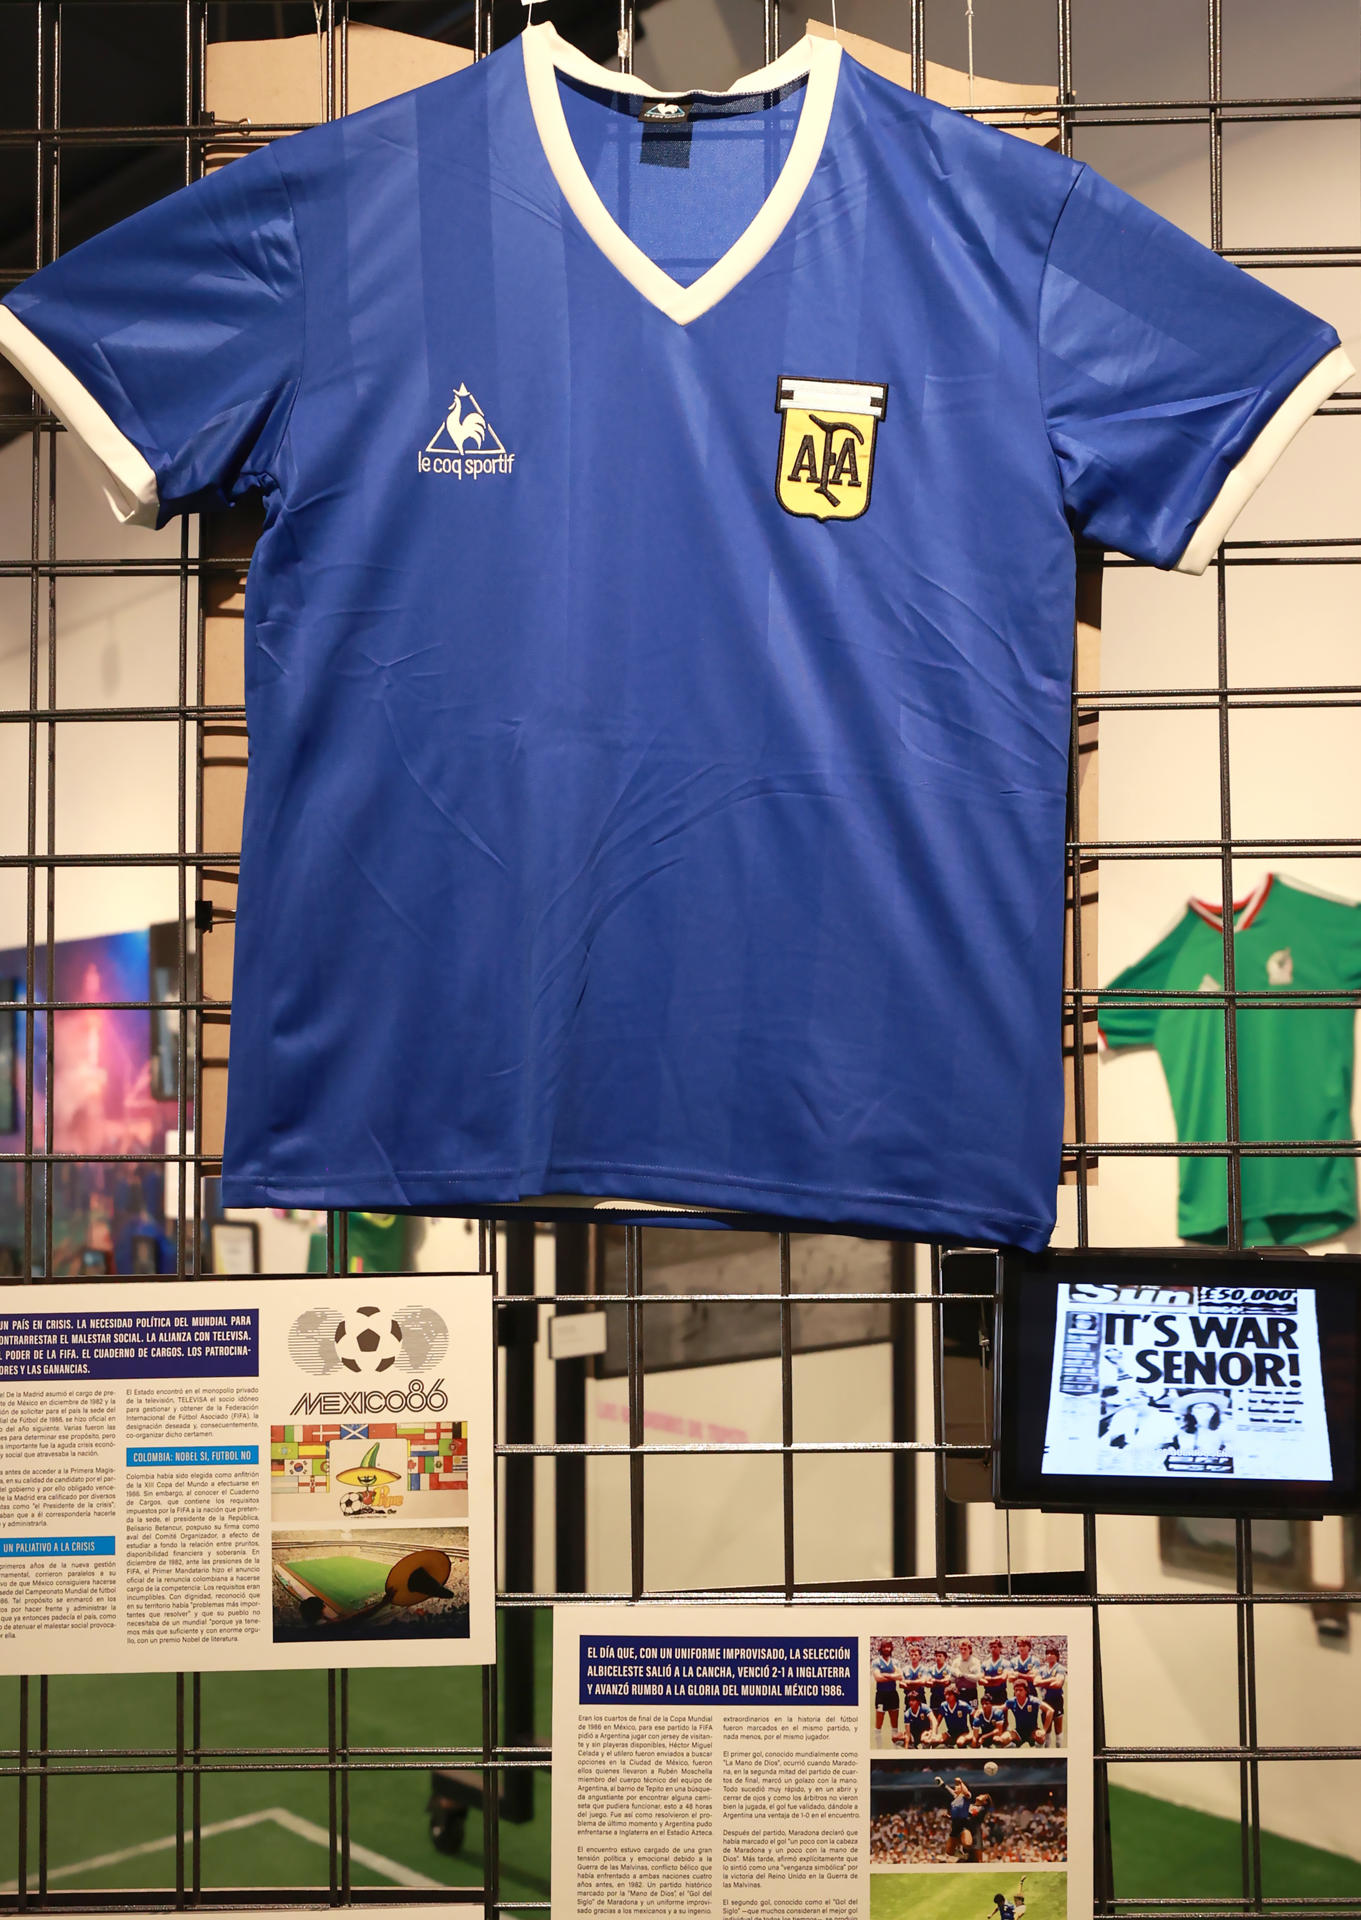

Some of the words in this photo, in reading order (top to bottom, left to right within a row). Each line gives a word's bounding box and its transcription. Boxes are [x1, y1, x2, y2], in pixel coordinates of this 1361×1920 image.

[418, 450, 431, 473] le
[433, 457, 462, 480] coq
[464, 453, 515, 480] sportif
[787, 413, 864, 508] AFA
[12, 1318, 30, 1330] PAÍS
[33, 1320, 43, 1330] EN
[46, 1320, 74, 1330] CRISIS.
[77, 1319, 87, 1329] LA
[90, 1318, 133, 1329] NECESIDAD
[136, 1315, 171, 1328] POLÍTICA
[174, 1317, 189, 1327] DEL
[192, 1317, 228, 1327] MUNDIAL
[231, 1316, 251, 1326] PARA
[60, 1334, 69, 1344] EL
[71, 1334, 112, 1344] MALESTAR
[114, 1333, 144, 1343] SOCIAL.
[146, 1333, 157, 1343] LA
[159, 1332, 192, 1342] ALIANZA
[194, 1332, 210, 1342] CON
[213, 1331, 251, 1341] TELEVISA.
[1105, 1313, 1180, 1347] IT'S
[1190, 1316, 1299, 1349] WAR
[5, 1350, 31, 1360] PODER
[34, 1350, 44, 1360] DE
[47, 1350, 57, 1359] LA
[60, 1349, 79, 1359] FIFA.
[82, 1349, 91, 1359] EL
[94, 1348, 135, 1359] CUADERNO
[138, 1348, 148, 1358] DE
[151, 1348, 184, 1358] CARGOS.
[187, 1347, 202, 1357] LOS
[205, 1346, 251, 1357] PATROCINA-
[20, 1365, 25, 1375] Y
[27, 1365, 42, 1375] LAS
[43, 1364, 90, 1374] GANANCIAS.
[1135, 1350, 1302, 1388] SENOR!
[133, 1452, 173, 1462] COLOMBIA:
[175, 1452, 198, 1462] NOBEL
[200, 1451, 210, 1463] SI,
[212, 1451, 238, 1461] FUTBOL
[241, 1451, 251, 1461] NO
[3, 1543, 14, 1553] UN
[16, 1542, 52, 1552] PALIATIVO
[54, 1542, 59, 1552] A
[61, 1541, 70, 1551] LA
[72, 1541, 95, 1551] CRISIS
[588, 1647, 598, 1659] EL
[600, 1645, 615, 1659] DÍA
[617, 1648, 638, 1660] QUE,
[640, 1648, 658, 1659] CON
[660, 1648, 673, 1659] UN
[675, 1648, 721, 1659] UNIFORME
[723, 1648, 787, 1661] IMPROVISADO,
[790, 1648, 801, 1660] LA
[803, 1646, 851, 1660] SELECCIÓN
[587, 1666, 644, 1677] ALBICELESTE
[646, 1664, 672, 1677] SALIÓ
[674, 1666, 680, 1678] A
[683, 1666, 694, 1678] LA
[696, 1666, 735, 1679] CANCHA,
[737, 1664, 770, 1678] VENCIÓ
[772, 1667, 785, 1678] 2-1
[788, 1667, 794, 1678] A
[796, 1667, 851, 1678] INGLATERRA
[587, 1684, 593, 1695] Y
[595, 1682, 630, 1696] AVANZÓ
[631, 1684, 664, 1696] RUMBO
[666, 1685, 672, 1696] A
[674, 1685, 686, 1696] LA
[688, 1685, 720, 1696] GLORIA
[722, 1685, 739, 1696] DEL
[741, 1685, 782, 1696] MUNDIAL
[784, 1682, 819, 1696] MÉXICO
[821, 1685, 845, 1696] 1986.
